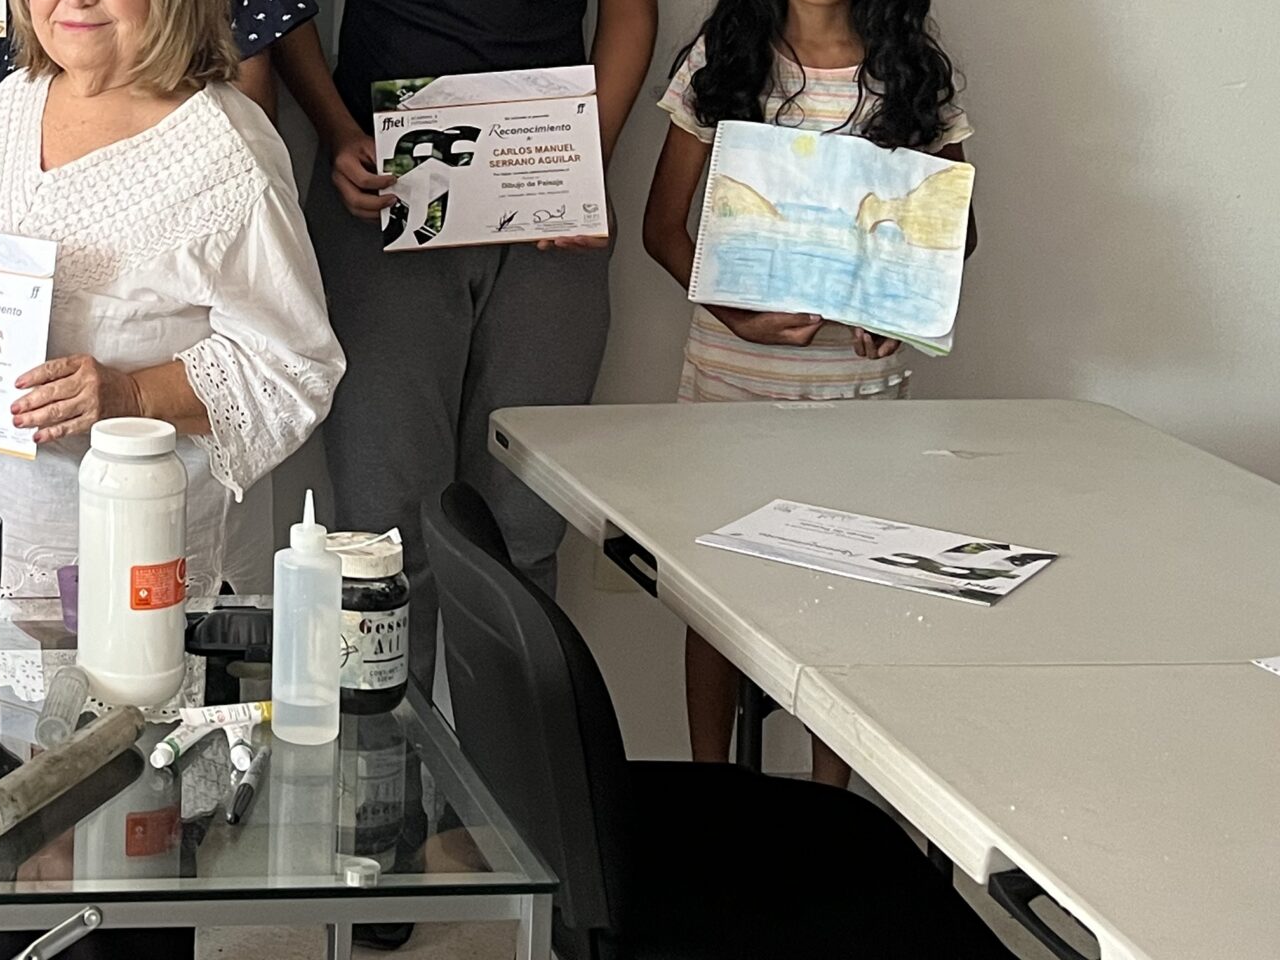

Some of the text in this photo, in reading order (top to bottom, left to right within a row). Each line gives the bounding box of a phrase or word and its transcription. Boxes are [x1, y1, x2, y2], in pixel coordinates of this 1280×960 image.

[488, 123, 572, 139] Reconocimiento
[493, 143, 575, 156] CARLOS MANUEL
[489, 154, 581, 168] SERRANO AGUILAR
[501, 181, 525, 189] Dibujo
[359, 616, 407, 634] Gesso
